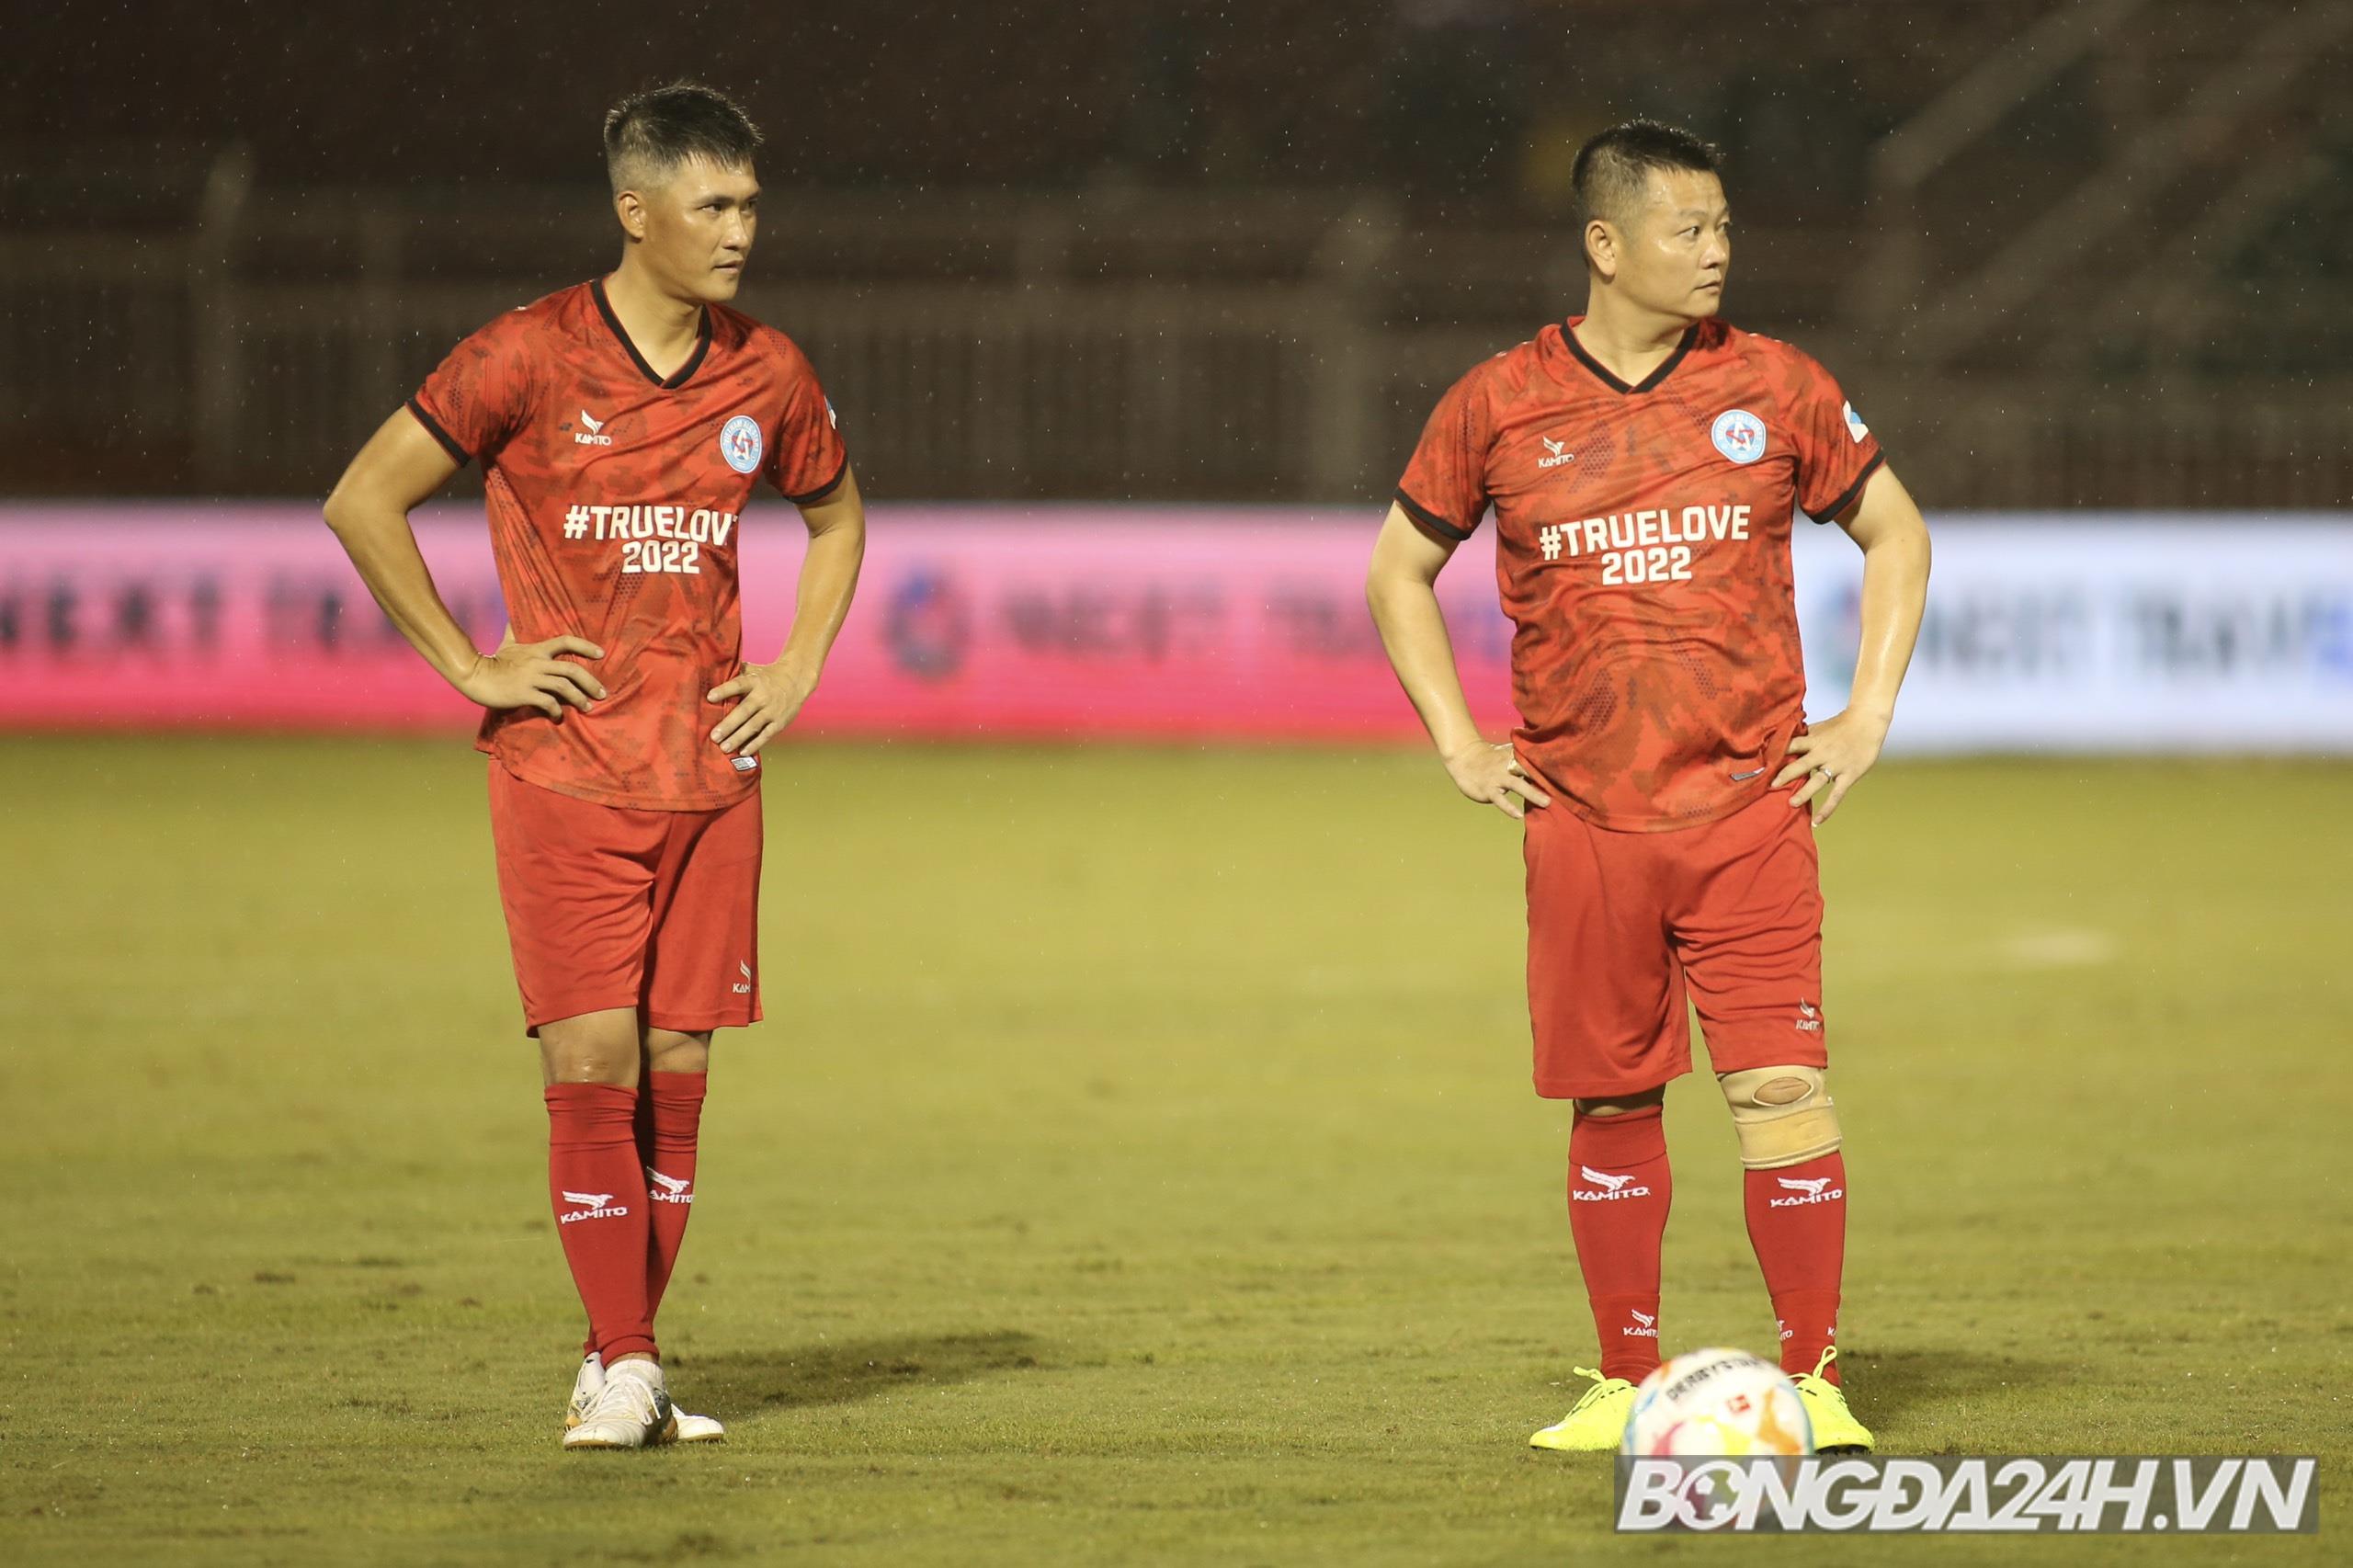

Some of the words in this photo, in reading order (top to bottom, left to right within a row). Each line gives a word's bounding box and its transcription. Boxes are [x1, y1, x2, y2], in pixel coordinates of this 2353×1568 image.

[574, 432, 611, 446] KAMITO
[1537, 453, 1574, 469] KAMITO
[563, 505, 738, 547] #TRUELOV
[1539, 505, 1751, 560] #TRUELOVE
[621, 540, 699, 574] 2022
[1601, 545, 1692, 585] 2022
[648, 1189, 693, 1204] AMITO
[1573, 1186, 1651, 1202] KAMITO
[1770, 1188, 1843, 1208] KAMITO
[560, 1206, 628, 1224] KAMITO
